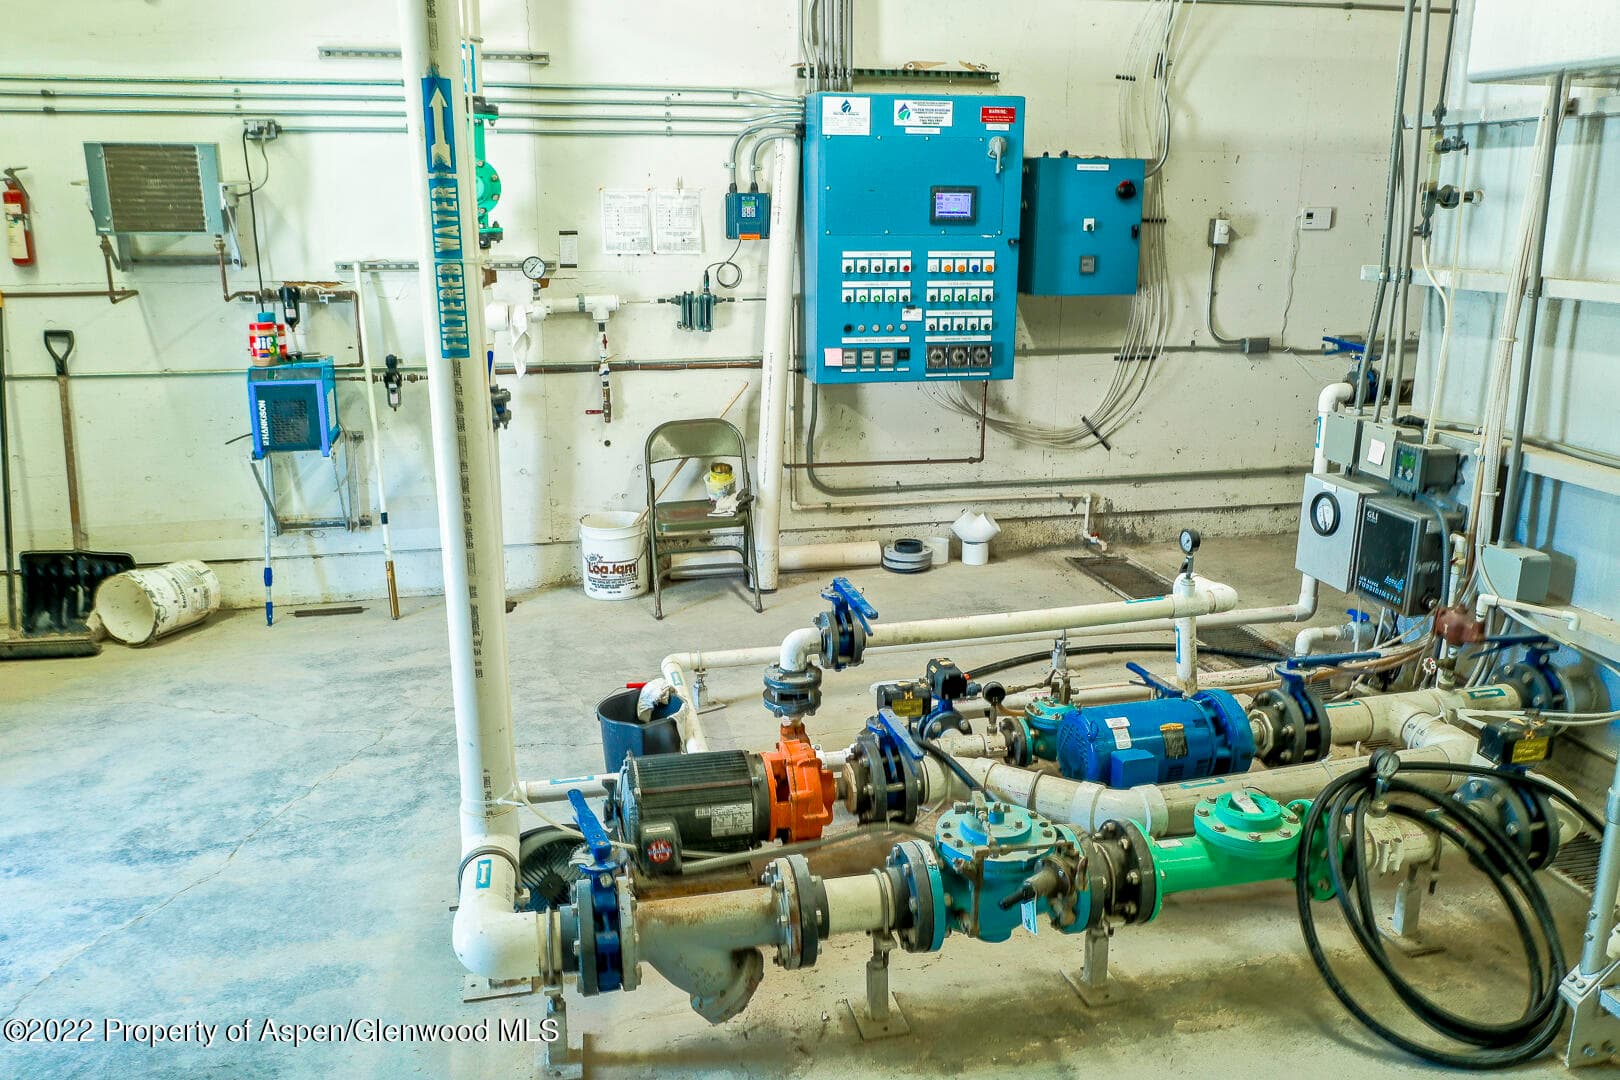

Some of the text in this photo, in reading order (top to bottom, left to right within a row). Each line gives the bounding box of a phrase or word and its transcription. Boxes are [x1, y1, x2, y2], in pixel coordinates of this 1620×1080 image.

[431, 187, 462, 253] WATER
[437, 263, 468, 351] FILTERED
[258, 400, 270, 440] HANKISON
